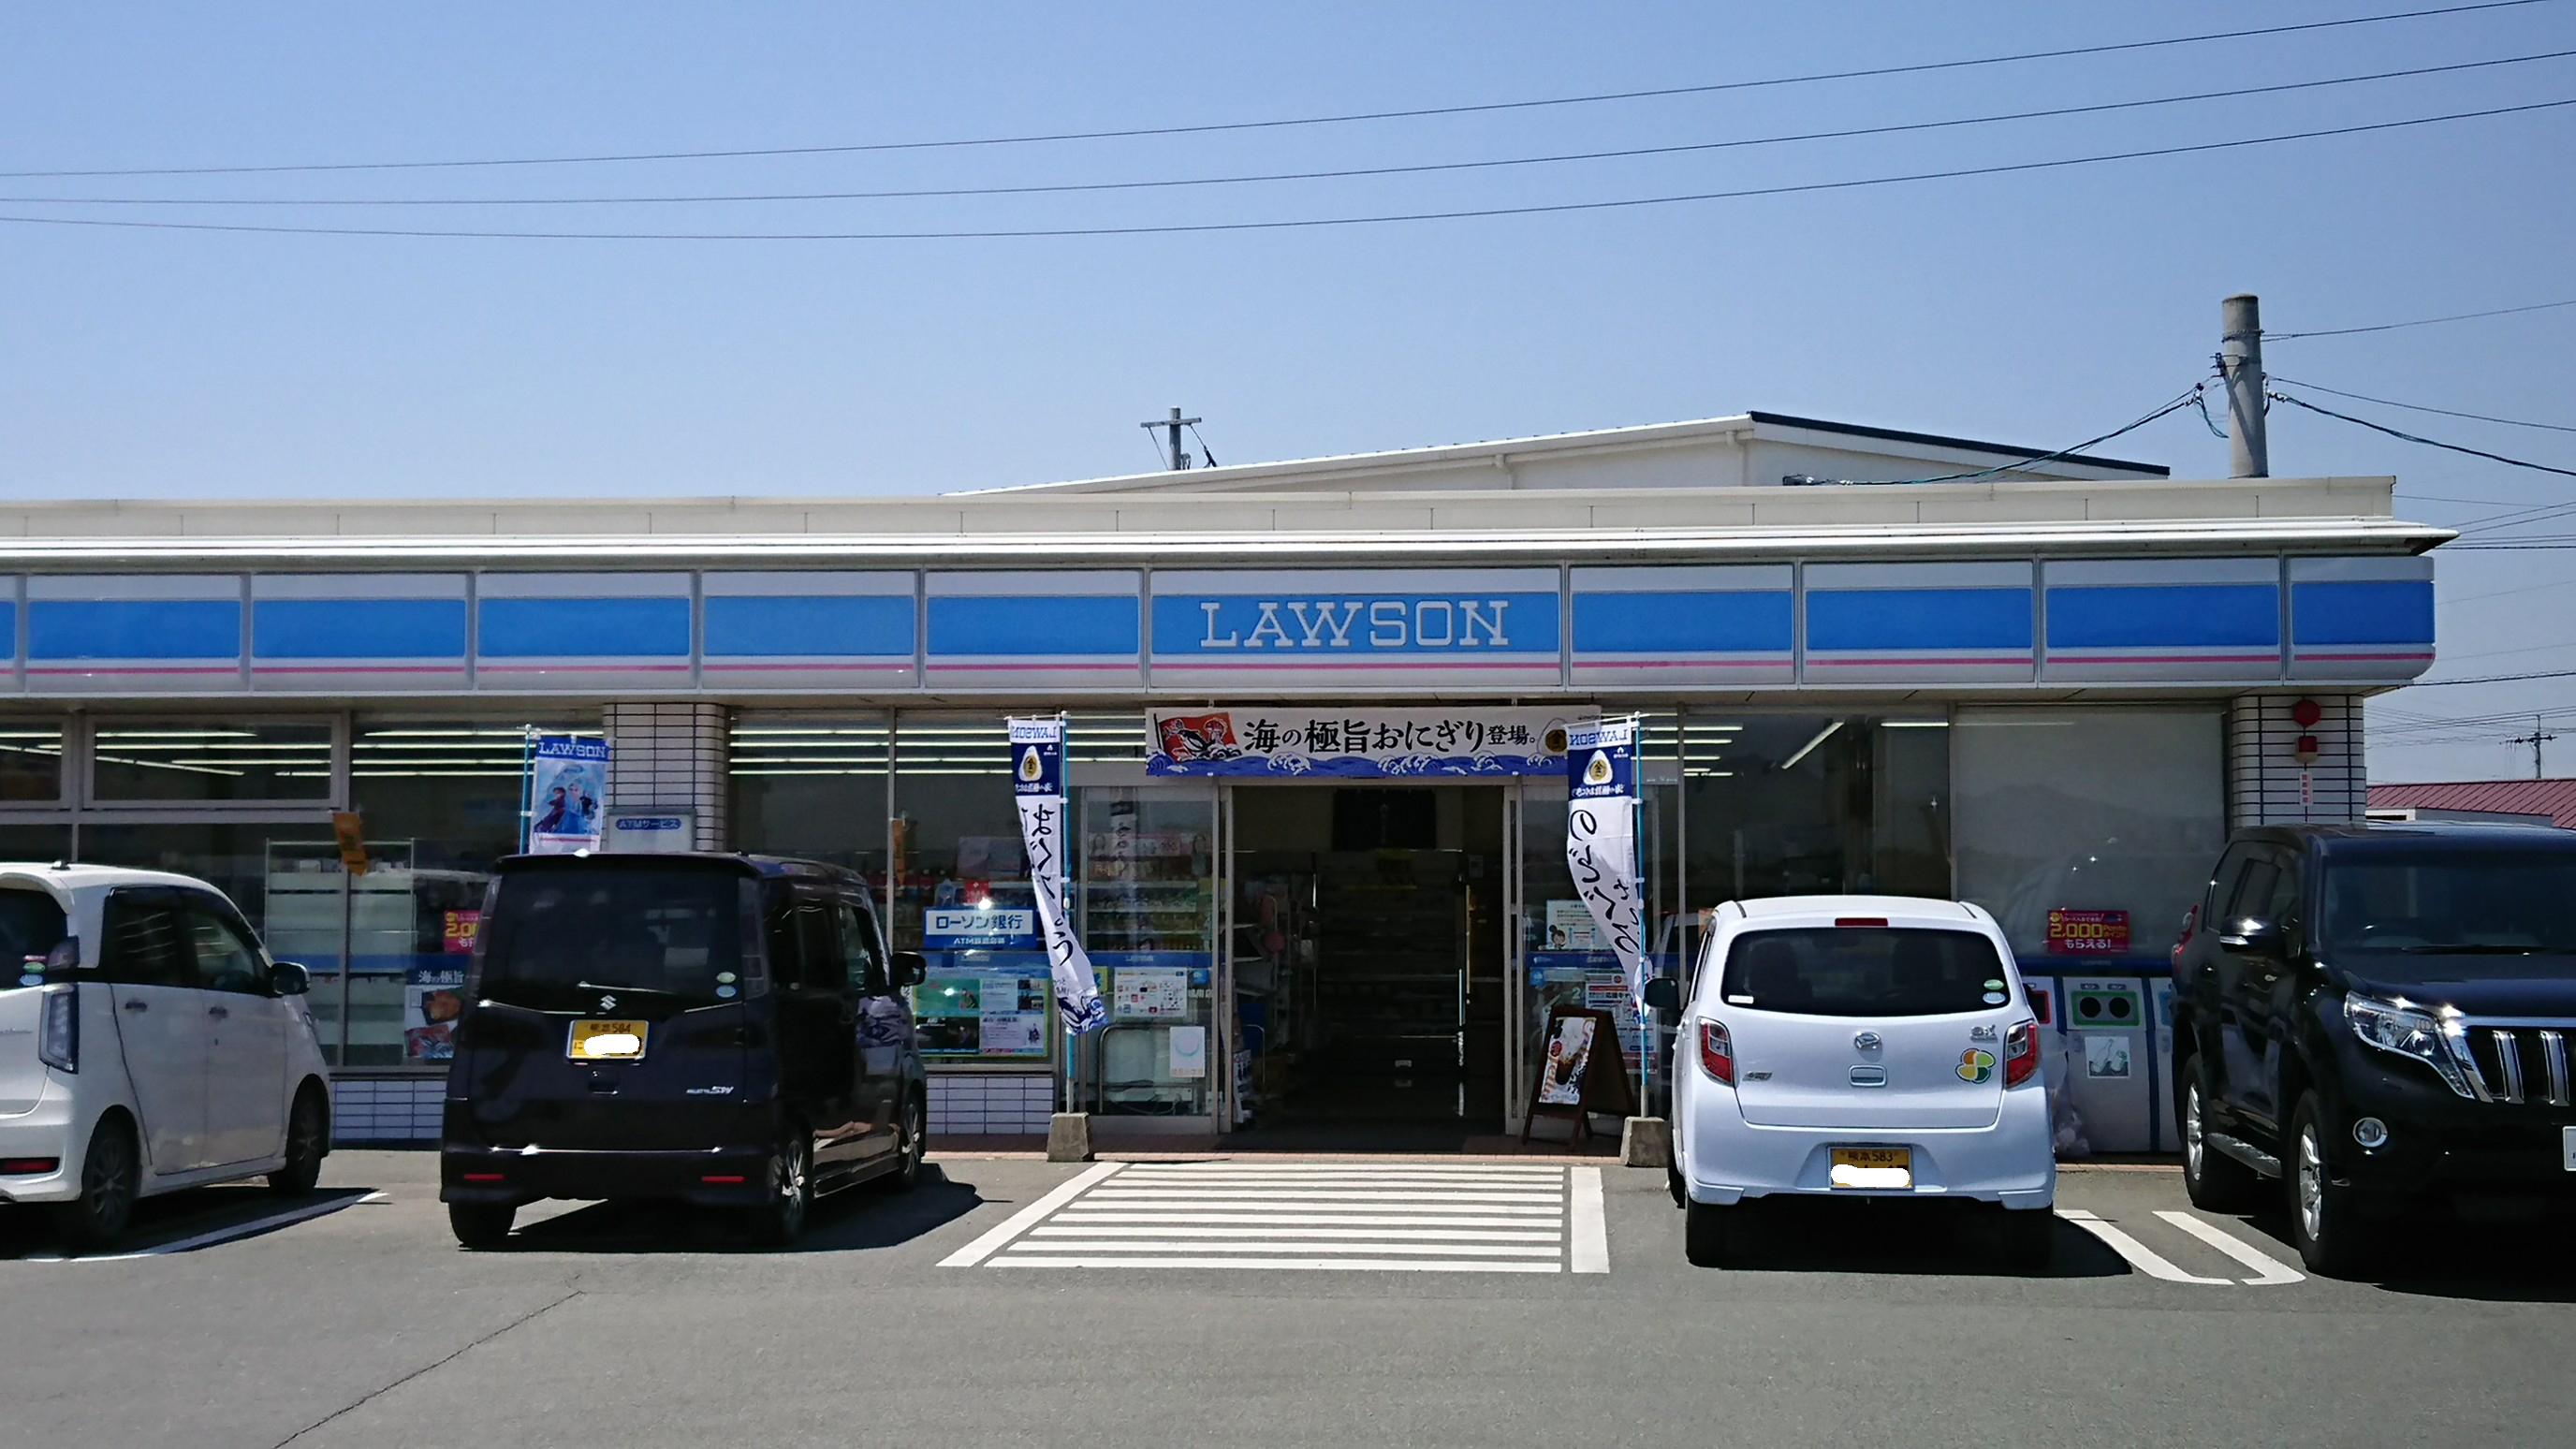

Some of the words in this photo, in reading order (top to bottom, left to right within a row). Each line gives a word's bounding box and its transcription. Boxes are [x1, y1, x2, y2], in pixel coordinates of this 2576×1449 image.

[1200, 601, 1510, 647] LAWSON
[538, 741, 607, 757] LAWSON
[618, 818, 680, 828] ATMサービス
[936, 915, 1023, 929] ローソン銀行
[2050, 923, 2103, 939] 2,000
